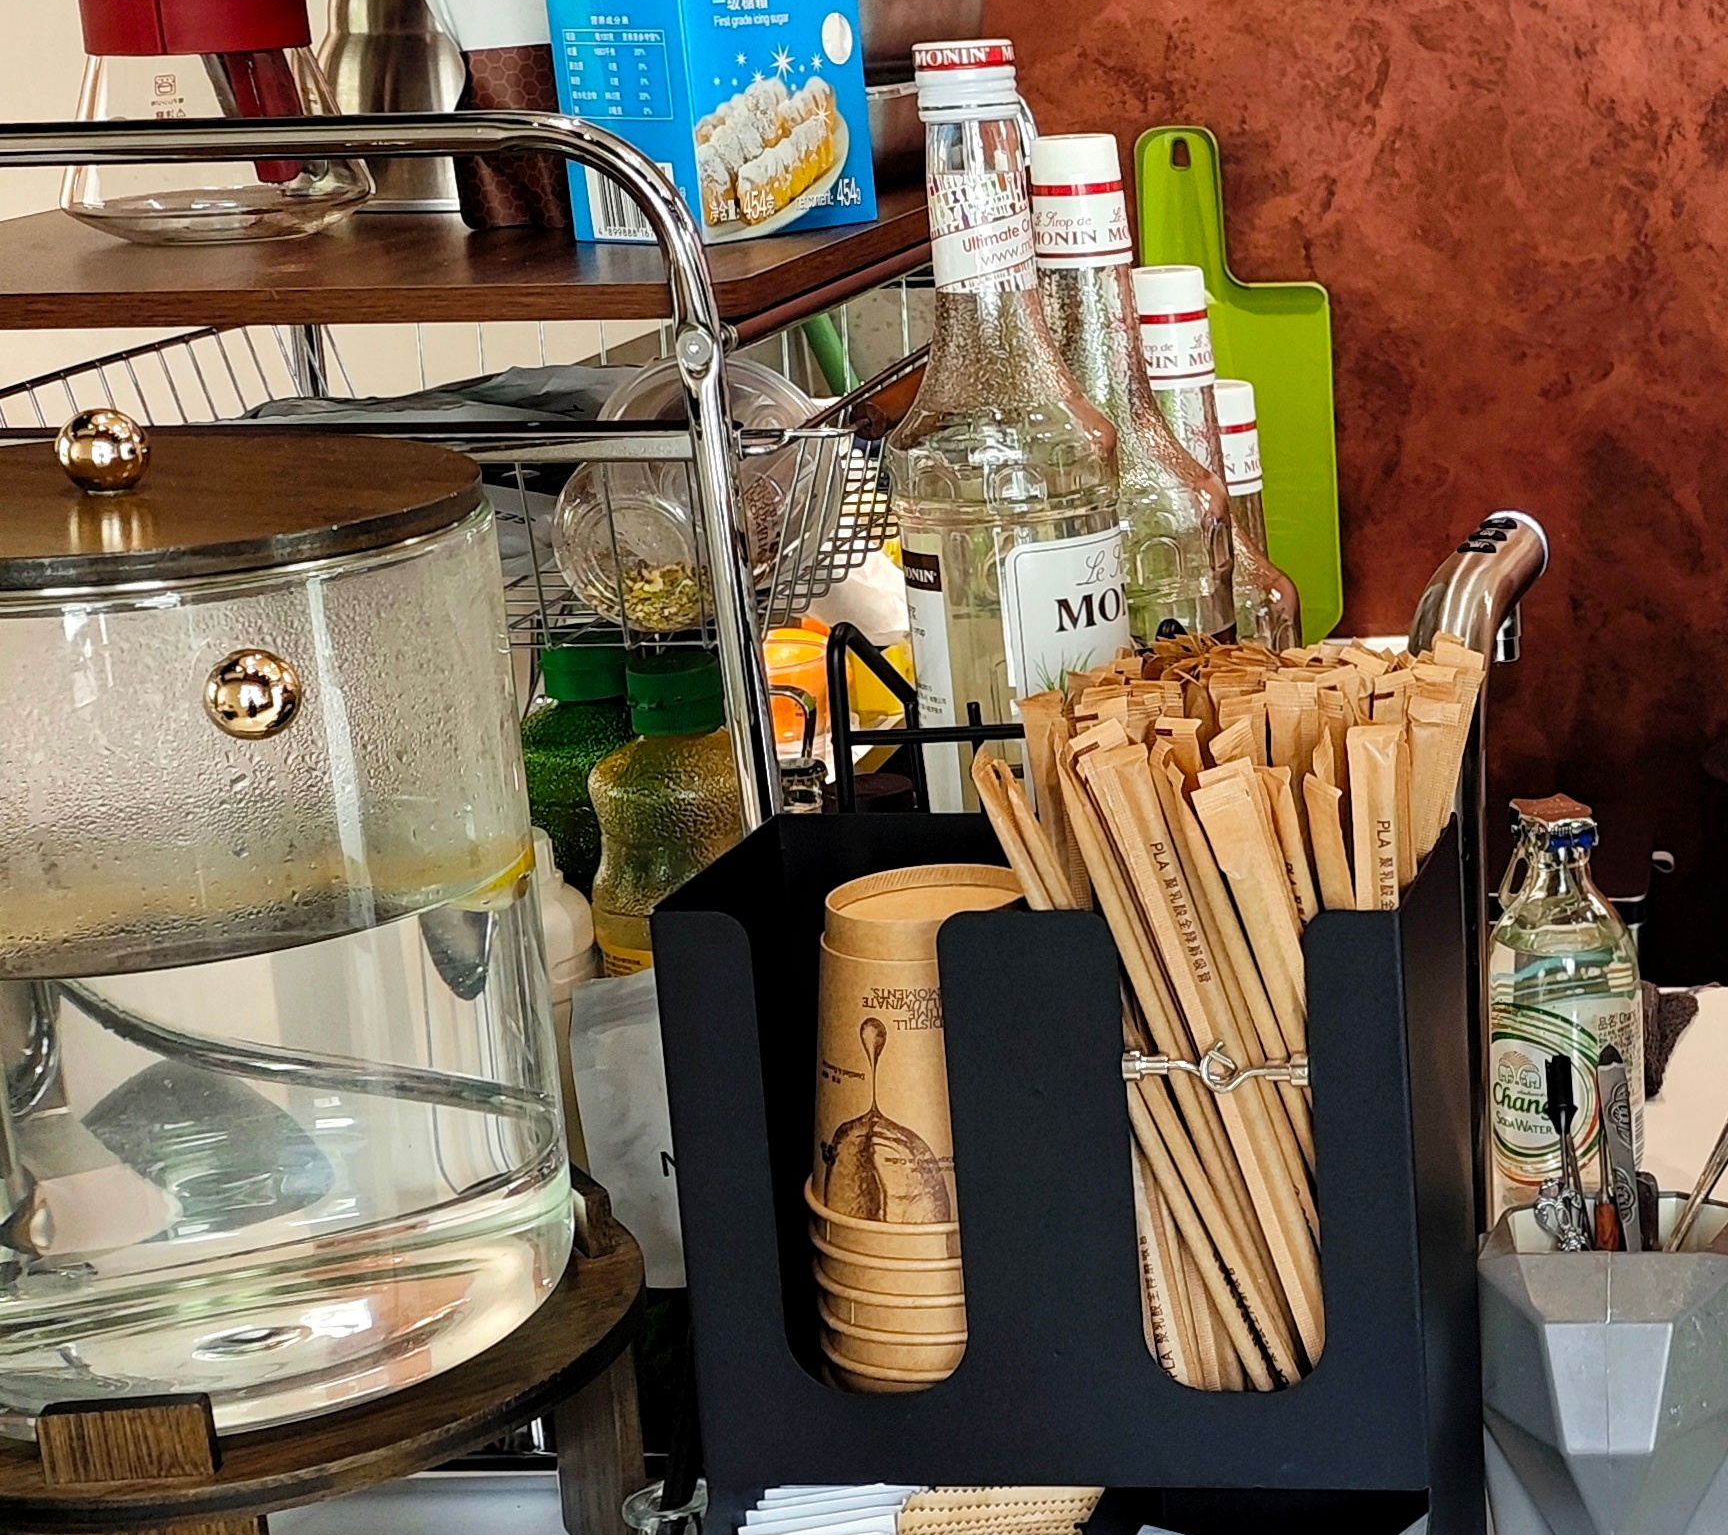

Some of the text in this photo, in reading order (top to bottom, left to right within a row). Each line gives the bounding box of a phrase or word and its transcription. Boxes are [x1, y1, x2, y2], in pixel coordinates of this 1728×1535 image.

[713, 13, 789, 28] First grade icing sugar
[962, 225, 1020, 253] Ultimate
[1376, 818, 1393, 849] PLA
[1150, 840, 1171, 872] PLA
[1515, 1117, 1554, 1135] WATER
